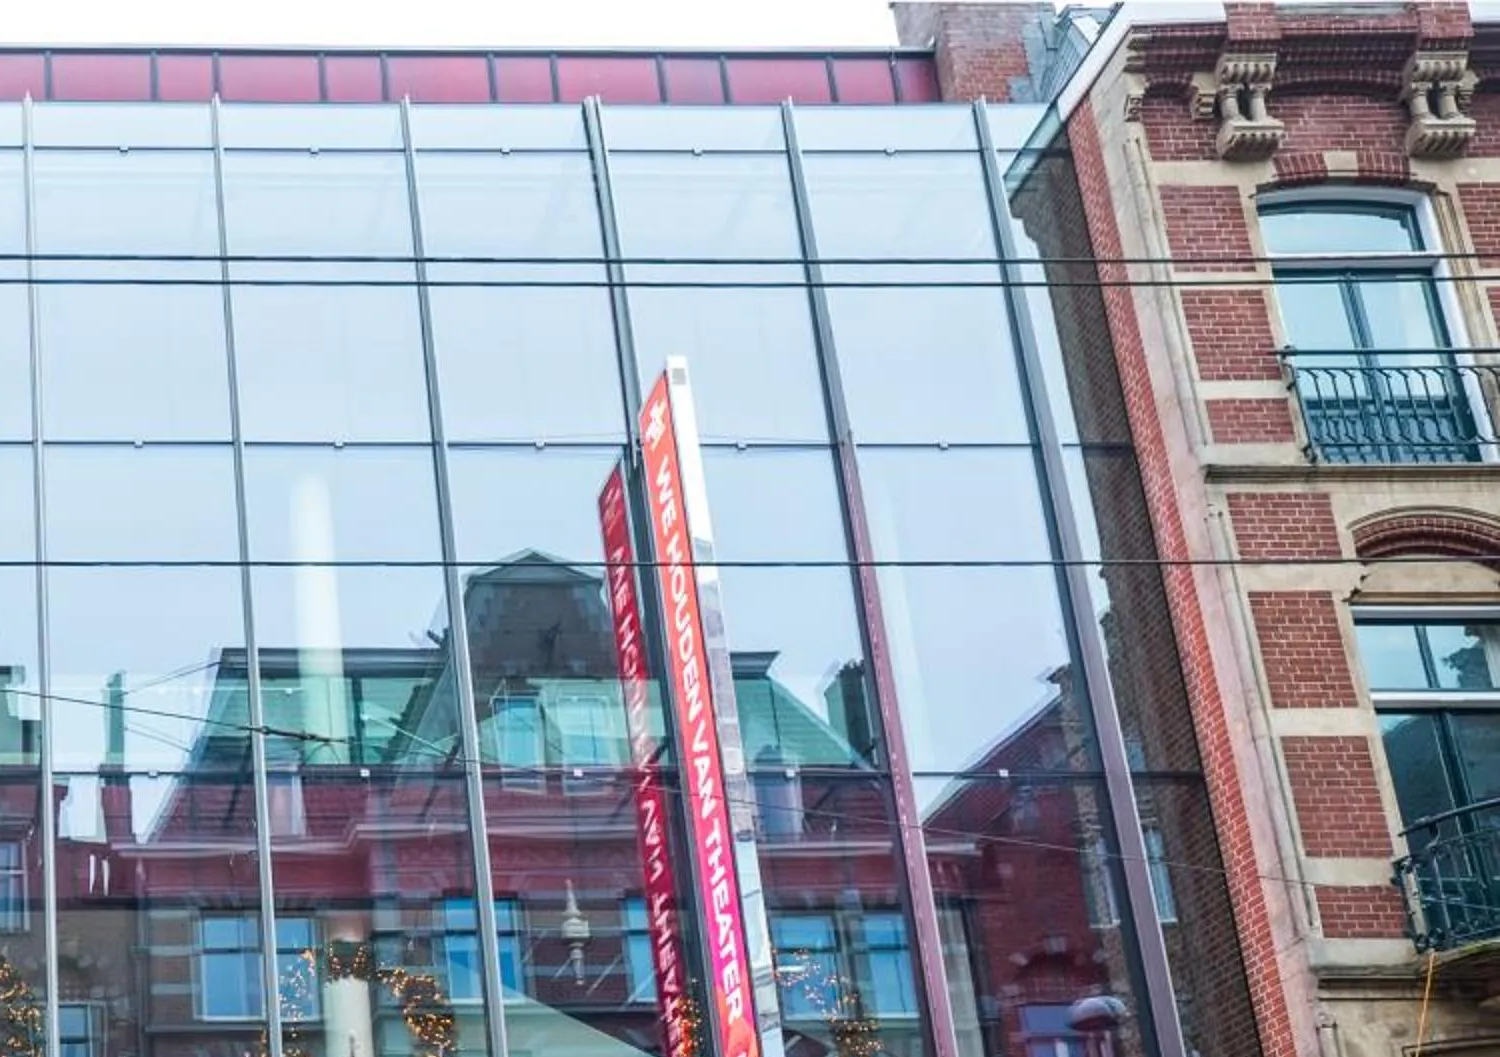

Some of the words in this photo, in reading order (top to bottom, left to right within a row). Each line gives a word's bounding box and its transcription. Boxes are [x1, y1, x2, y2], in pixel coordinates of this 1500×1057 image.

[656, 455, 677, 536] WE
[666, 531, 703, 723] HOUDEN
[692, 719, 717, 819] VAN
[705, 818, 743, 1025] THEATER
